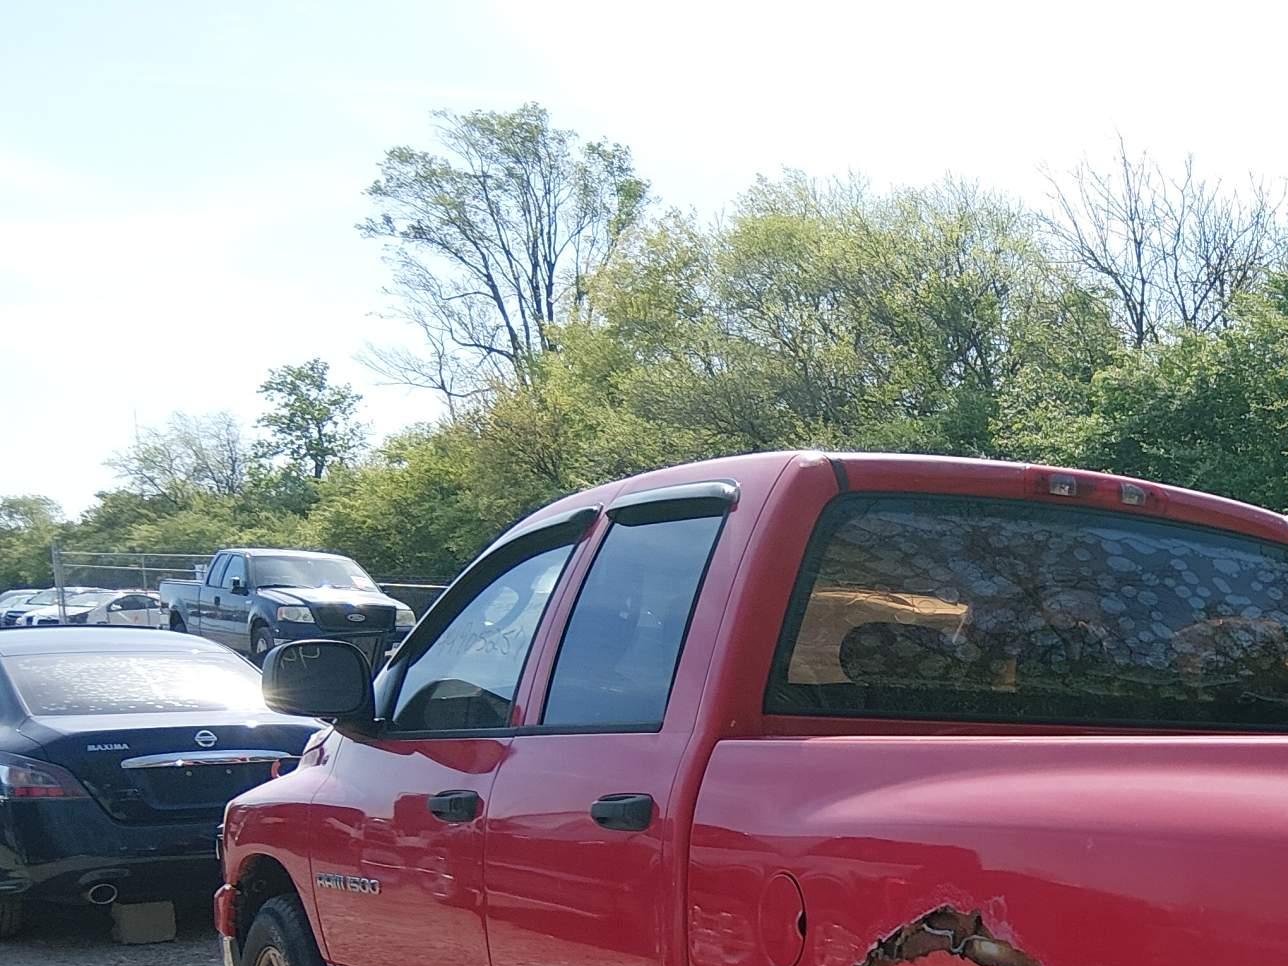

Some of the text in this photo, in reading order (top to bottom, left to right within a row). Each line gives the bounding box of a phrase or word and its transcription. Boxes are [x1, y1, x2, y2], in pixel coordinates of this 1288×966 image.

[87, 743, 130, 751] MAXIMA
[316, 872, 380, 895] RAM 1500
